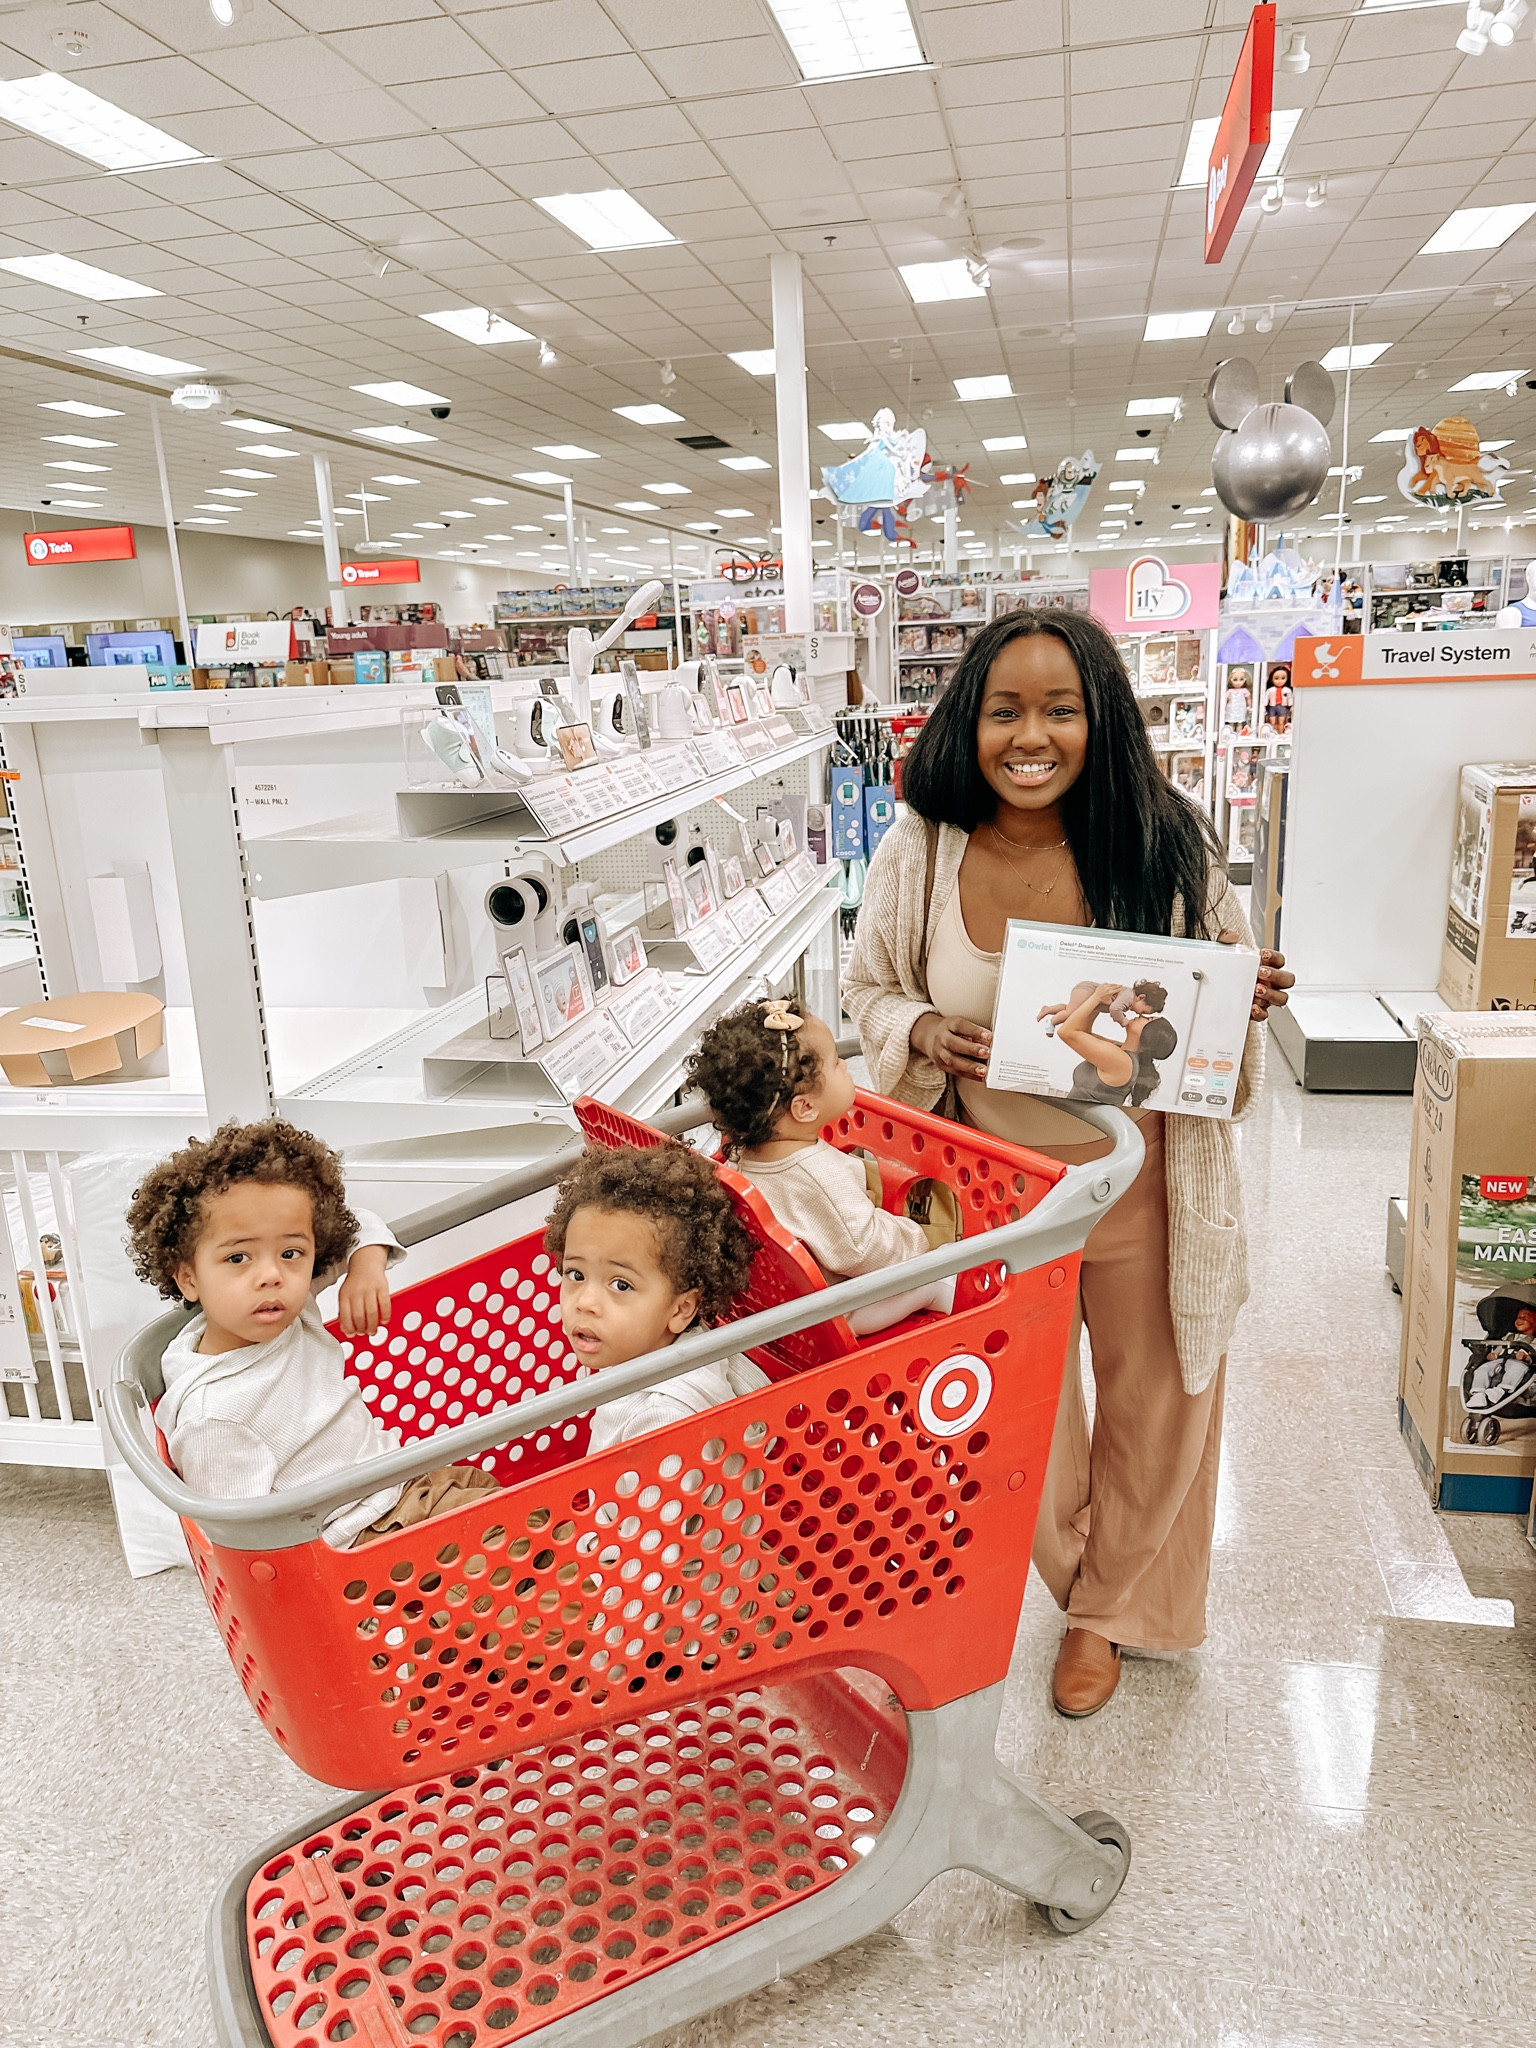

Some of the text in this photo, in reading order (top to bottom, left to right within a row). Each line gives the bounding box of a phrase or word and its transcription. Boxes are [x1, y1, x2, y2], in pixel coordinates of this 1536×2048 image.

[48, 542, 73, 554] Tech
[357, 569, 380, 578] Travel
[241, 631, 260, 639] Book
[330, 631, 368, 640] Young adult
[241, 638, 257, 646] Club
[811, 637, 819, 648] S
[811, 648, 818, 659] 3
[1381, 646, 1511, 665] Travel System
[18, 674, 26, 684] S
[20, 684, 26, 693] 3
[1028, 941, 1053, 951] Owlet
[1078, 942, 1095, 950] Dream
[1422, 1043, 1450, 1092] GRACO
[1486, 1181, 1523, 1194] NEW
[1474, 1245, 1536, 1263] MANE
